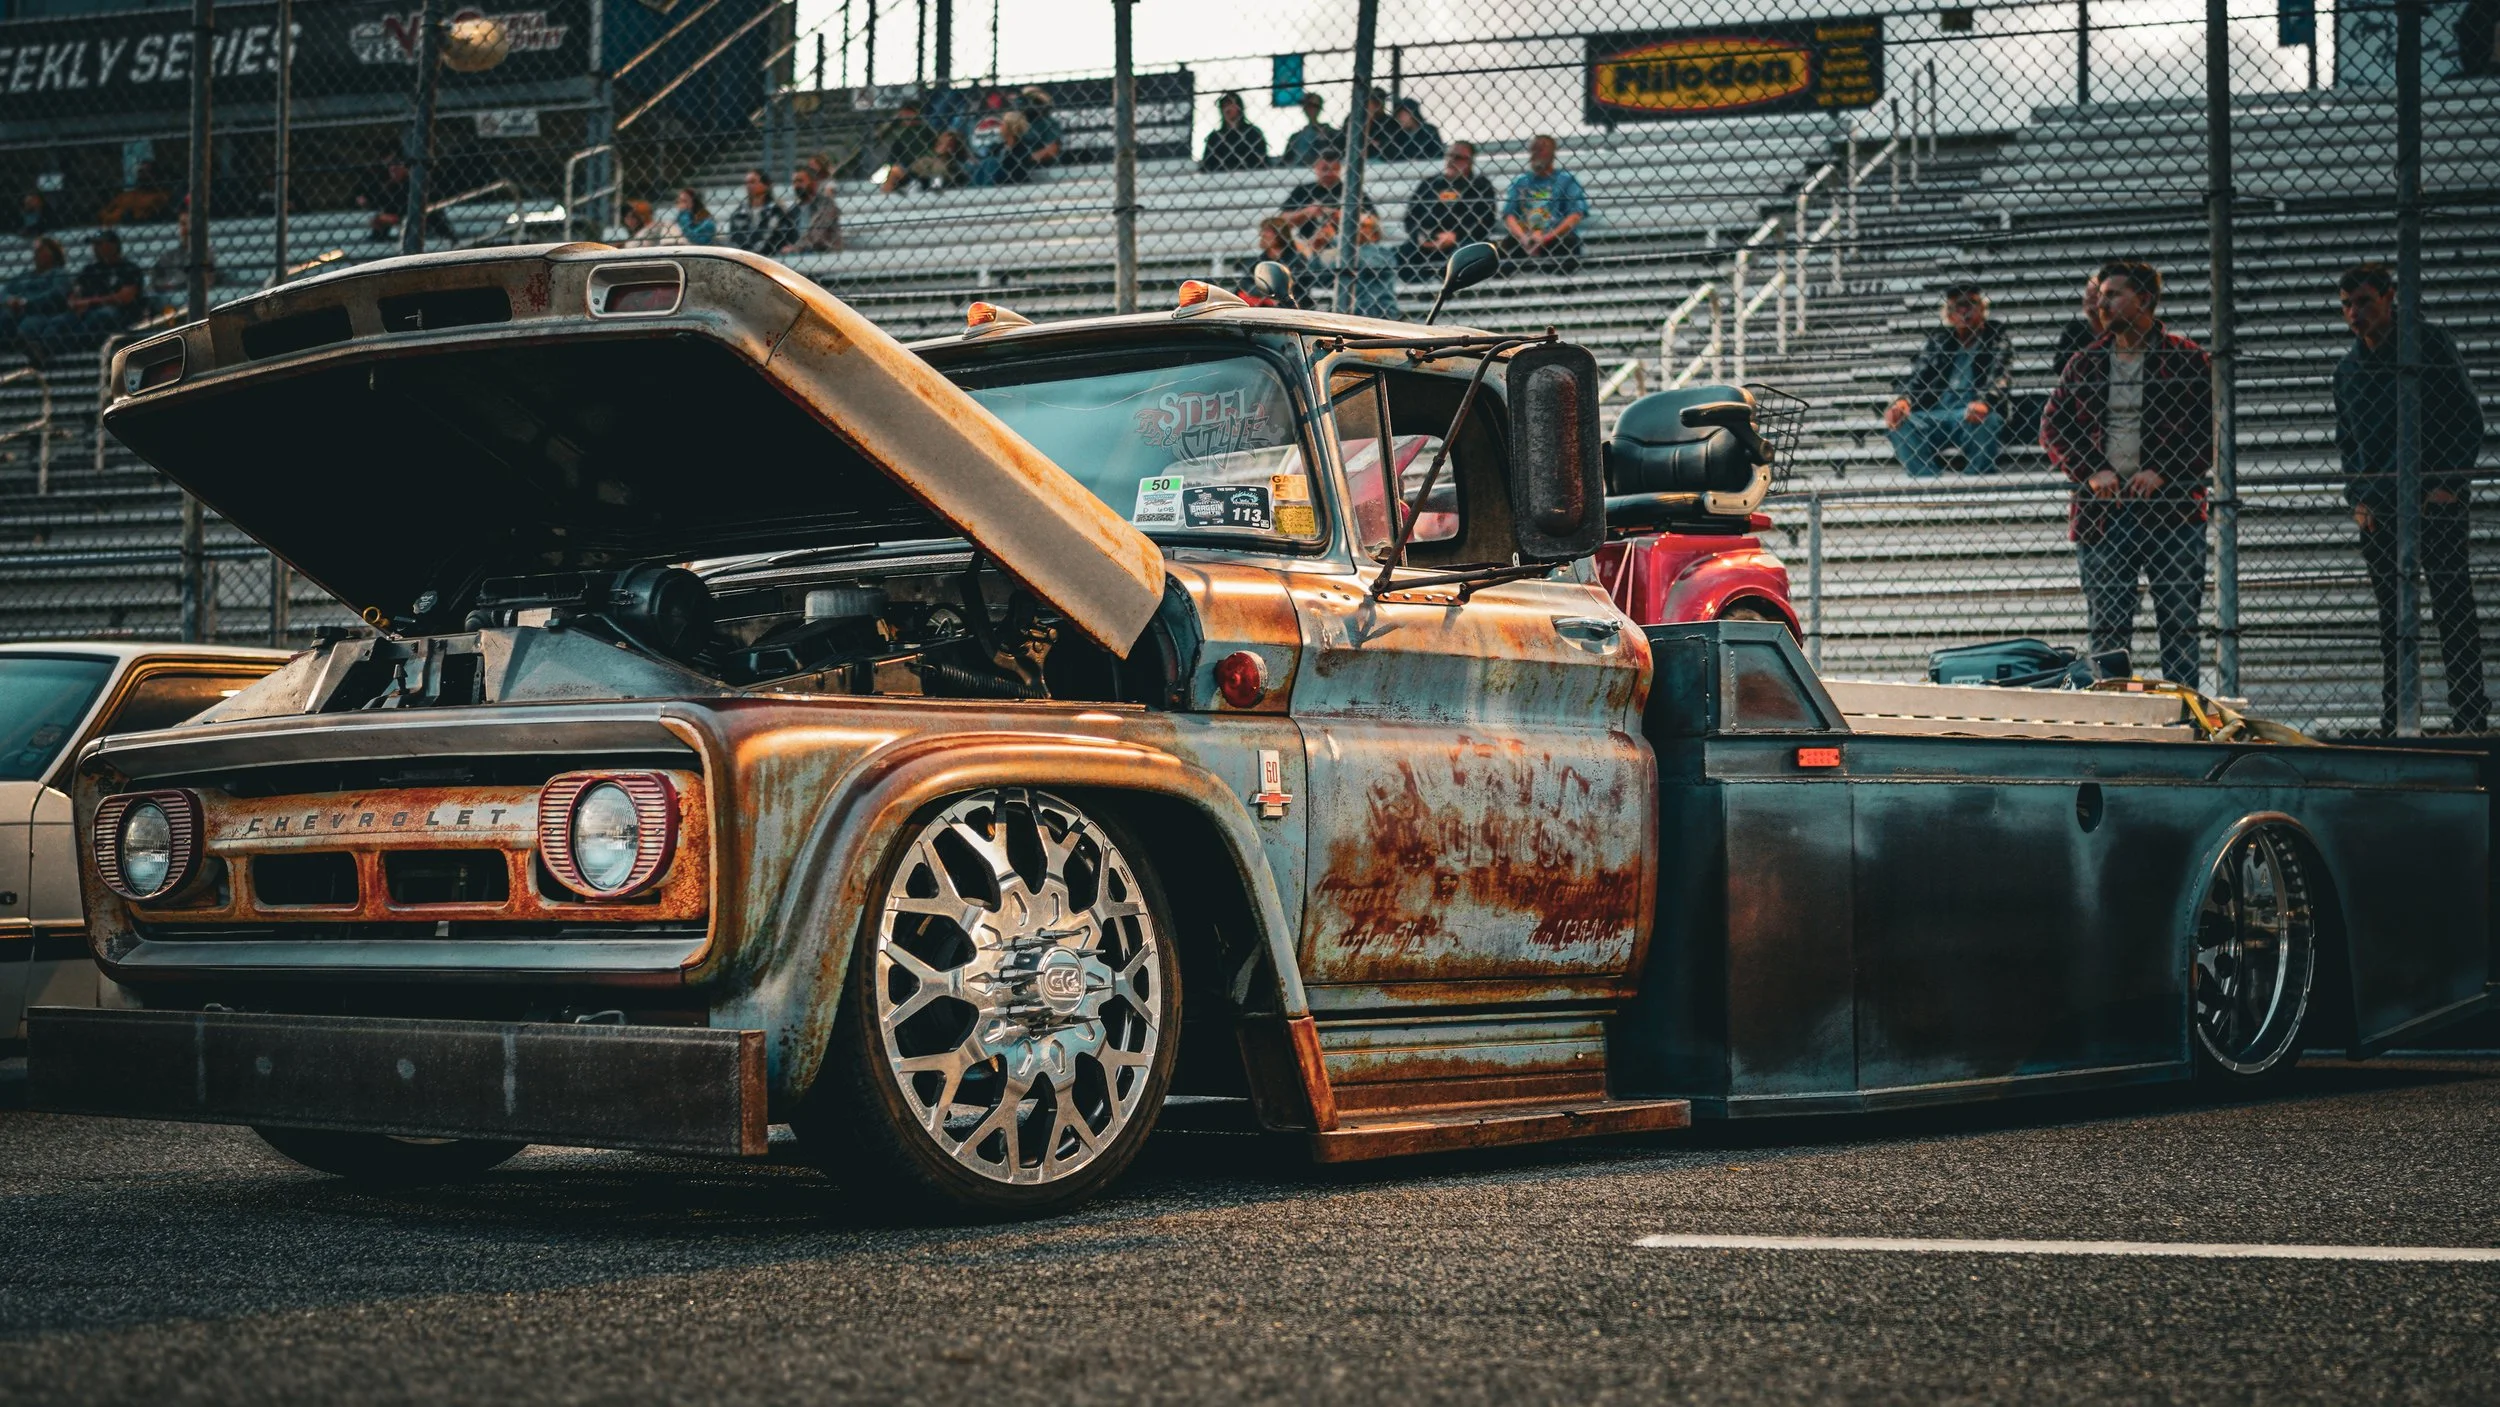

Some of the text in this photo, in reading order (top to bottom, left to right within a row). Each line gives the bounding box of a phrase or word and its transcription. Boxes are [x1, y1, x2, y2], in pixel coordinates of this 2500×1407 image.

[1614, 59, 1791, 94] Milodon
[1158, 387, 1255, 431] STEEL
[1179, 415, 1270, 471] STYLE
[1151, 479, 1170, 491] 50
[1232, 507, 1262, 523] 113
[1265, 761, 1279, 783] 60
[248, 809, 507, 833] CHEVROLET
